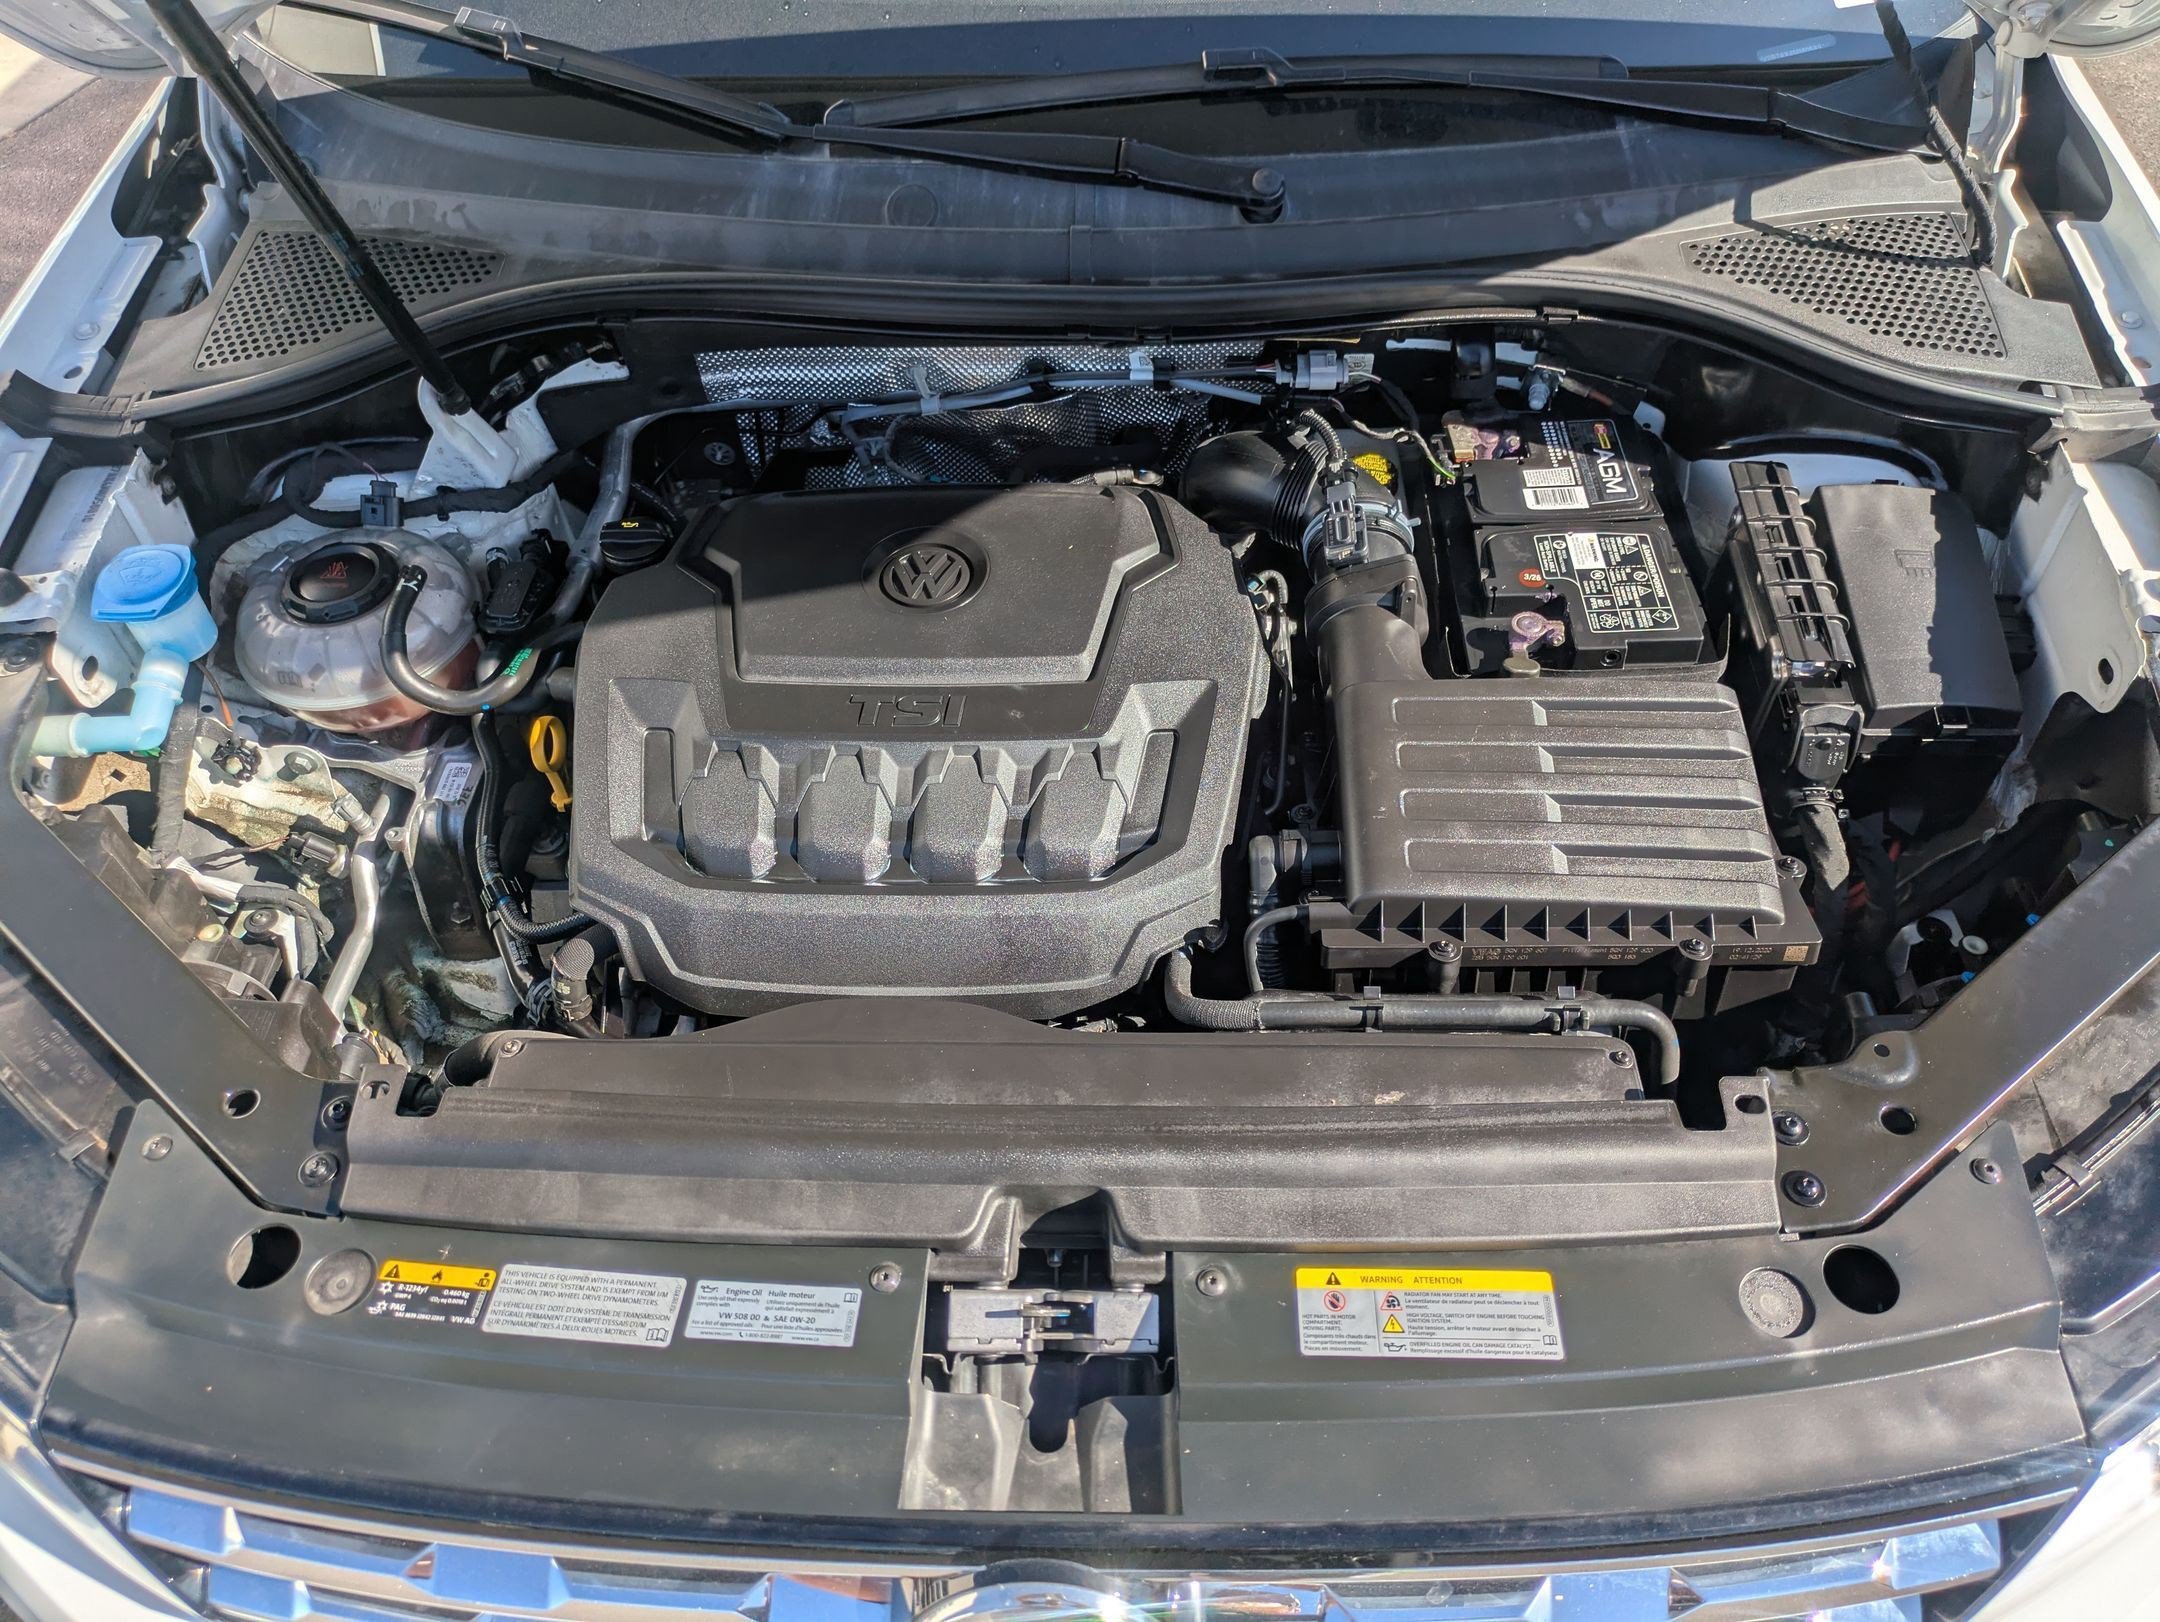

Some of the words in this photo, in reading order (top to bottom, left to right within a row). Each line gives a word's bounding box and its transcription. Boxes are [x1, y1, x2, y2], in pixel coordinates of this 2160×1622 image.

[1593, 448, 1627, 494] AGM
[1643, 549, 1665, 597] DANGER/POISON
[849, 695, 967, 727] TSI
[520, 1271, 548, 1279] VEHICLE
[556, 1274, 590, 1283] EQUIPPED
[616, 1279, 657, 1288] PERMANENT
[397, 1284, 430, 1295] R-1234yf
[499, 1287, 527, 1295] TESTING
[539, 1290, 581, 1299] TWO-WHEEL
[582, 1293, 602, 1301] DRIVE
[502, 1278, 538, 1287] ALL-WHEEL
[539, 1281, 559, 1289] DRIVE
[559, 1283, 585, 1291] SYSTEM
[610, 1287, 636, 1295] EXEMPT
[636, 1289, 656, 1297] FROM
[726, 1288, 751, 1297] Engine
[390, 1303, 407, 1312] PAG
[566, 1306, 584, 1314] D'UN
[622, 1311, 671, 1321] TRANSMISSION
[525, 1313, 564, 1321] PERMANENT
[789, 1316, 816, 1324] 0W-20
[561, 1324, 581, 1332] DEUX
